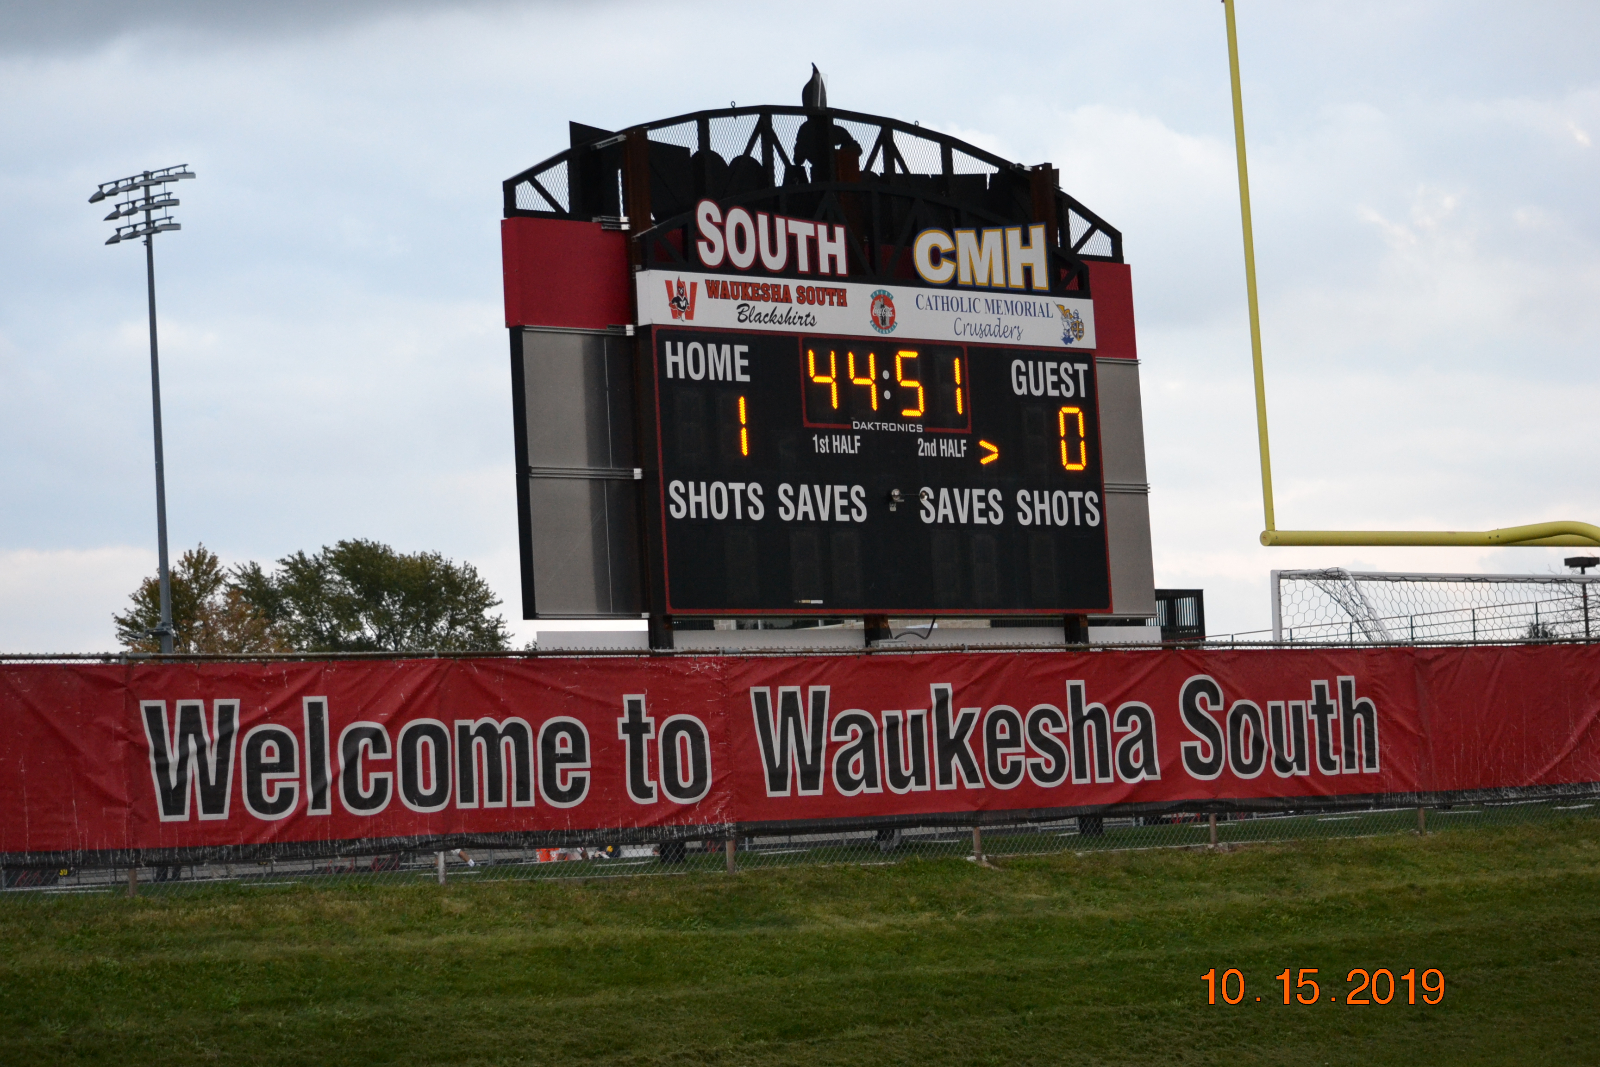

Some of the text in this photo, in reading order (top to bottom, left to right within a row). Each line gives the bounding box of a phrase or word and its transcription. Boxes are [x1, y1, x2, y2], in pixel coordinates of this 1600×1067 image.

[696, 199, 848, 276] SOUTH
[913, 222, 1051, 292] CMH
[705, 279, 792, 303] WAUKESHA
[796, 285, 848, 307] SOUTH
[915, 294, 981, 314] CATHOLIC
[984, 299, 1053, 318] MEMORIAL
[736, 303, 817, 327] Blackshirts
[954, 317, 1023, 341] Crusaders
[665, 341, 750, 382] HOME
[1011, 359, 1088, 398] GUEST
[738, 396, 748, 456] 1
[812, 434, 861, 454] 1st HALF
[852, 421, 924, 433] DAKTRONICS
[1058, 406, 1087, 471] 0
[917, 438, 967, 458] 2nd HALF
[669, 479, 765, 521] SHOTS
[778, 482, 868, 523] SAVES
[919, 486, 1004, 526] SAVES
[1016, 489, 1100, 528] SHOTS
[139, 674, 1381, 823] Welcome to Waukesha South
